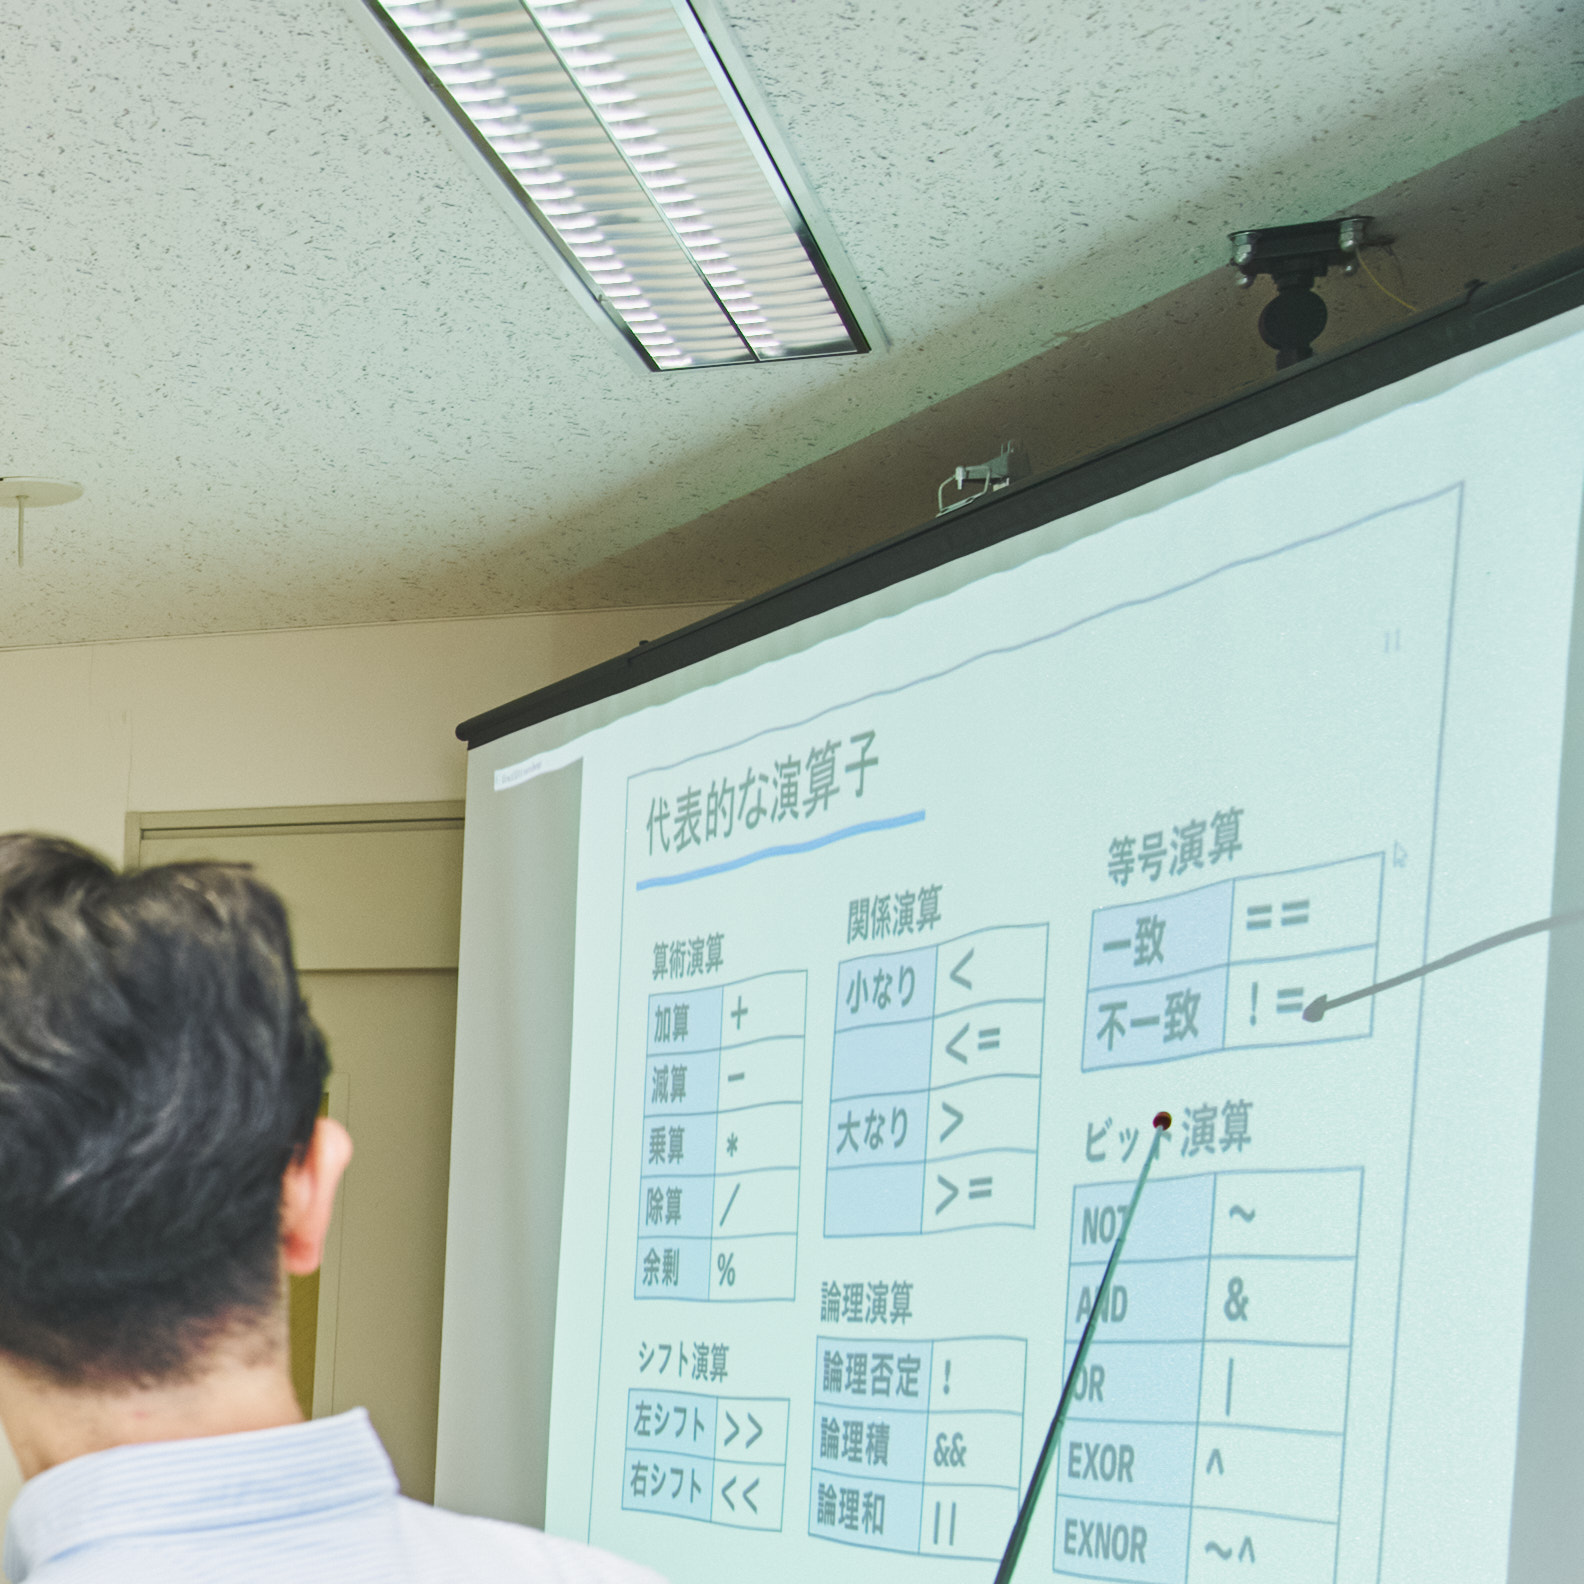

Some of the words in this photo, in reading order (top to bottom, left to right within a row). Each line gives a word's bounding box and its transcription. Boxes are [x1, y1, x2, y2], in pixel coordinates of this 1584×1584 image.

[646, 729, 879, 856] 代表的な演算子
[1107, 806, 1244, 887] 等号演算
[847, 884, 943, 944] 関係演算
[1102, 914, 1166, 968] 一致
[1246, 899, 1310, 931] ==
[652, 932, 725, 981] 算術演算
[846, 965, 916, 1015] 小なり
[950, 947, 975, 991] <
[654, 1003, 690, 1043] 加算
[730, 995, 749, 1031] +
[1096, 987, 1202, 1051] 不一致
[945, 1022, 1001, 1065] <=
[651, 1064, 687, 1104] 減算
[648, 1125, 685, 1165] 乗算
[837, 1105, 909, 1155] 大なり
[939, 1101, 964, 1143] >
[1085, 1099, 1254, 1163] ビッ演算
[646, 1186, 683, 1227] 除算
[719, 1182, 741, 1227] /
[935, 1174, 993, 1215] >=
[642, 1247, 680, 1287] 余剰
[717, 1252, 736, 1286] %
[820, 1280, 914, 1325] 論理演算
[1224, 1276, 1250, 1322] &
[638, 1340, 730, 1383] シフト演算
[822, 1350, 922, 1398] 論理否定
[633, 1399, 705, 1441] 左シフト
[723, 1410, 763, 1448] >>
[819, 1416, 891, 1467] 論理積
[933, 1432, 967, 1468] &&
[1068, 1441, 1135, 1483] EXOR
[630, 1459, 702, 1503] 右シフト
[721, 1474, 761, 1515] <<
[816, 1482, 886, 1536] 論理和
[1063, 1517, 1147, 1564] EXNOR
